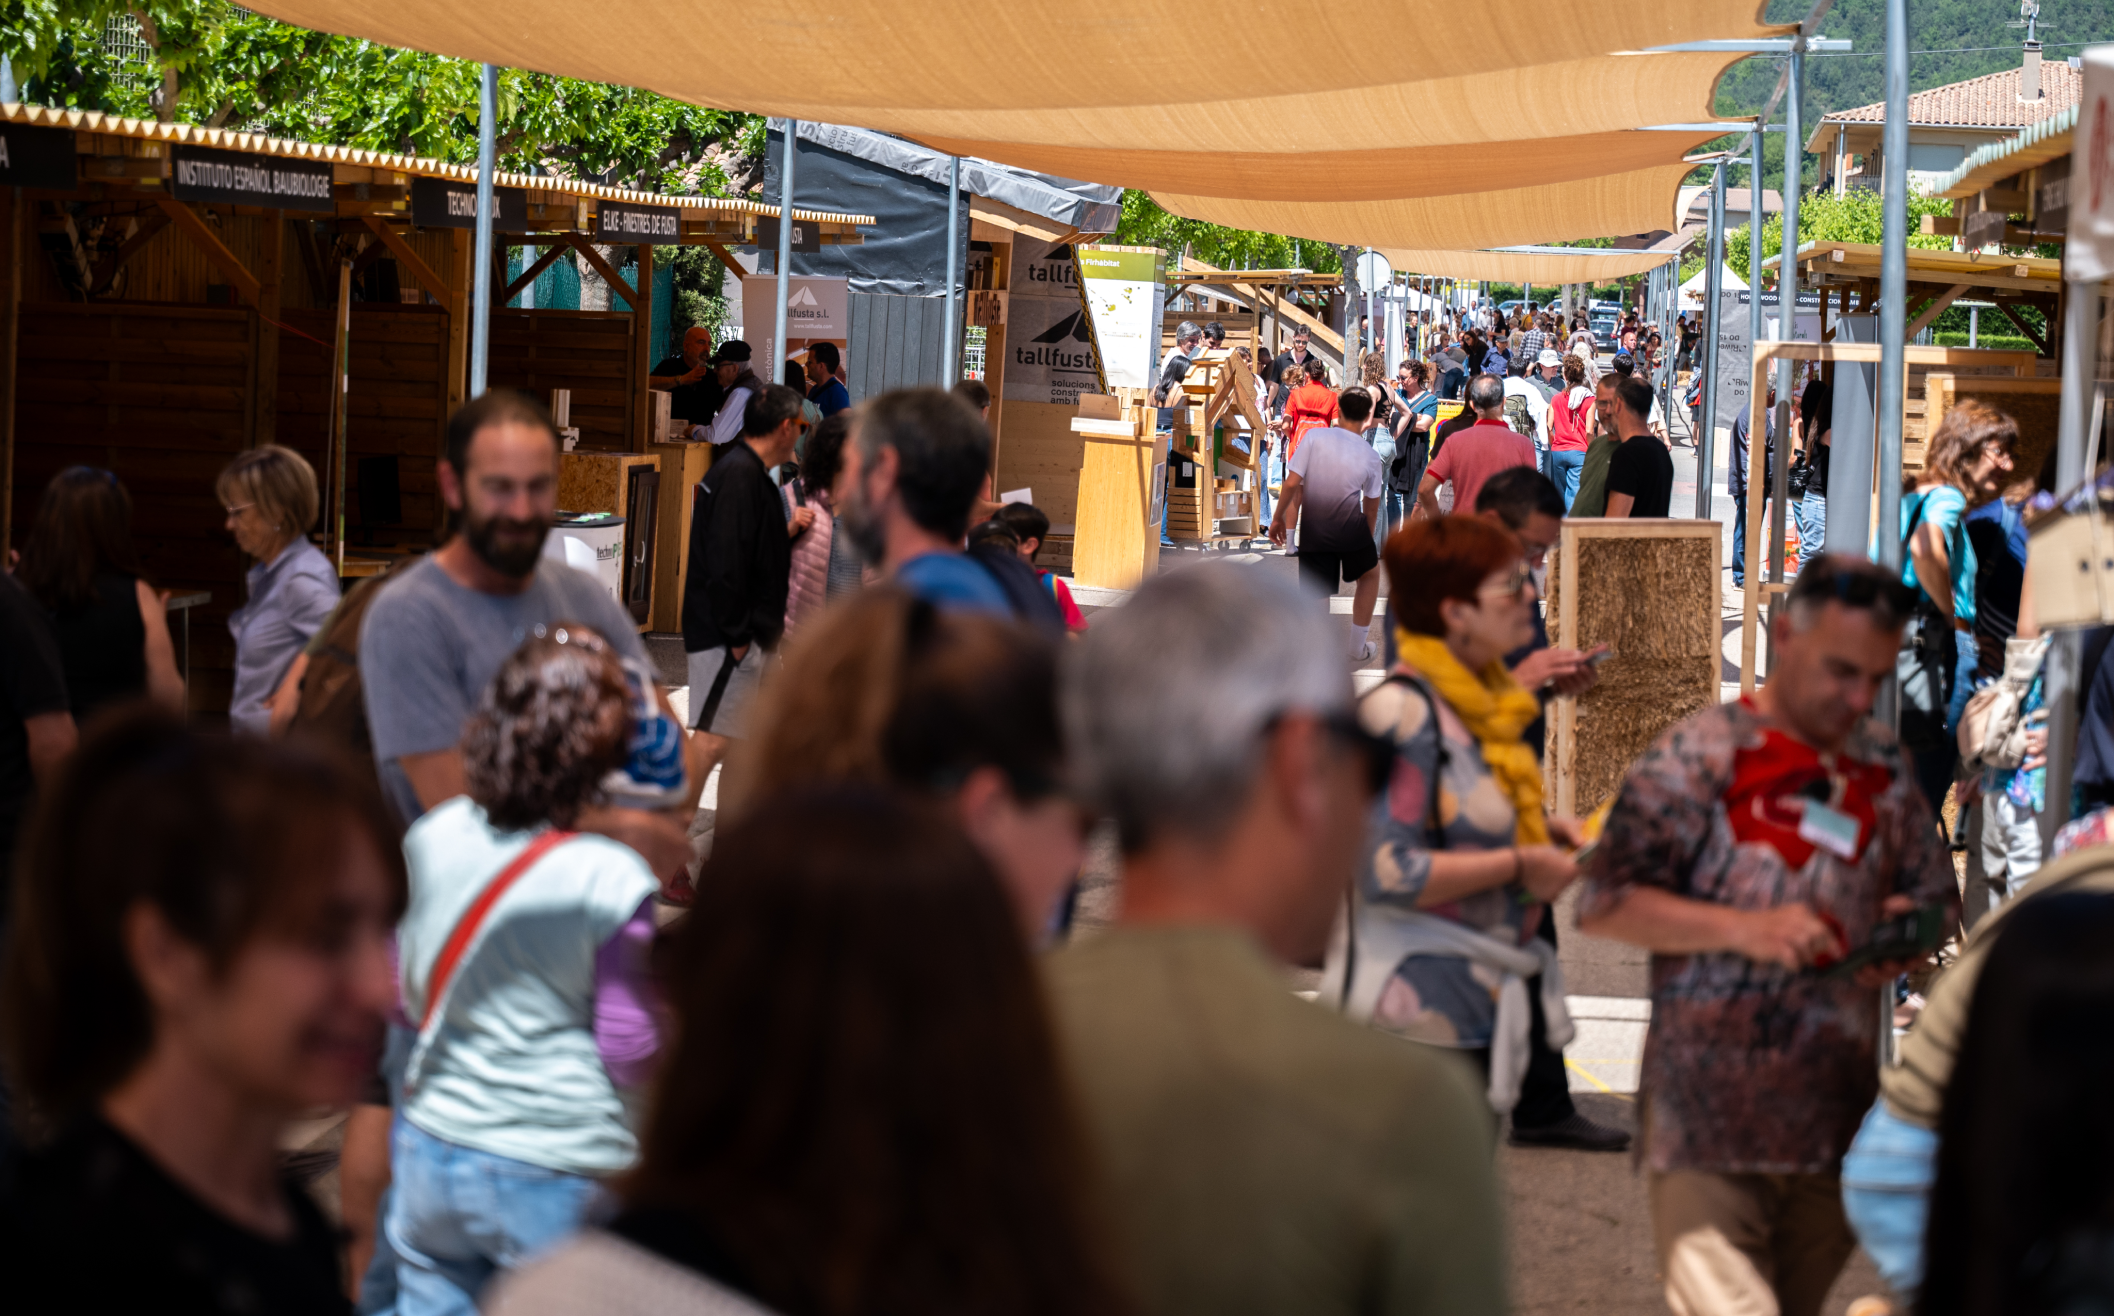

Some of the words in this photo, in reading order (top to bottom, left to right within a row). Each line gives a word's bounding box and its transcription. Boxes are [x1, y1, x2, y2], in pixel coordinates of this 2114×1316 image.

[177, 159, 233, 189] INSTITUTO
[234, 163, 272, 194] ESPAÑOL
[272, 171, 330, 198] BAUBIOLOGIE
[603, 210, 620, 232] ELKE
[623, 212, 651, 234] FINESTRES
[651, 215, 660, 235] DE
[660, 216, 677, 236] FUSTA
[787, 308, 815, 318] llfusta
[816, 309, 830, 319] s.l.
[1719, 343, 1739, 352] Riwe
[1051, 380, 1096, 390] solucions
[1050, 397, 1071, 405] amb
